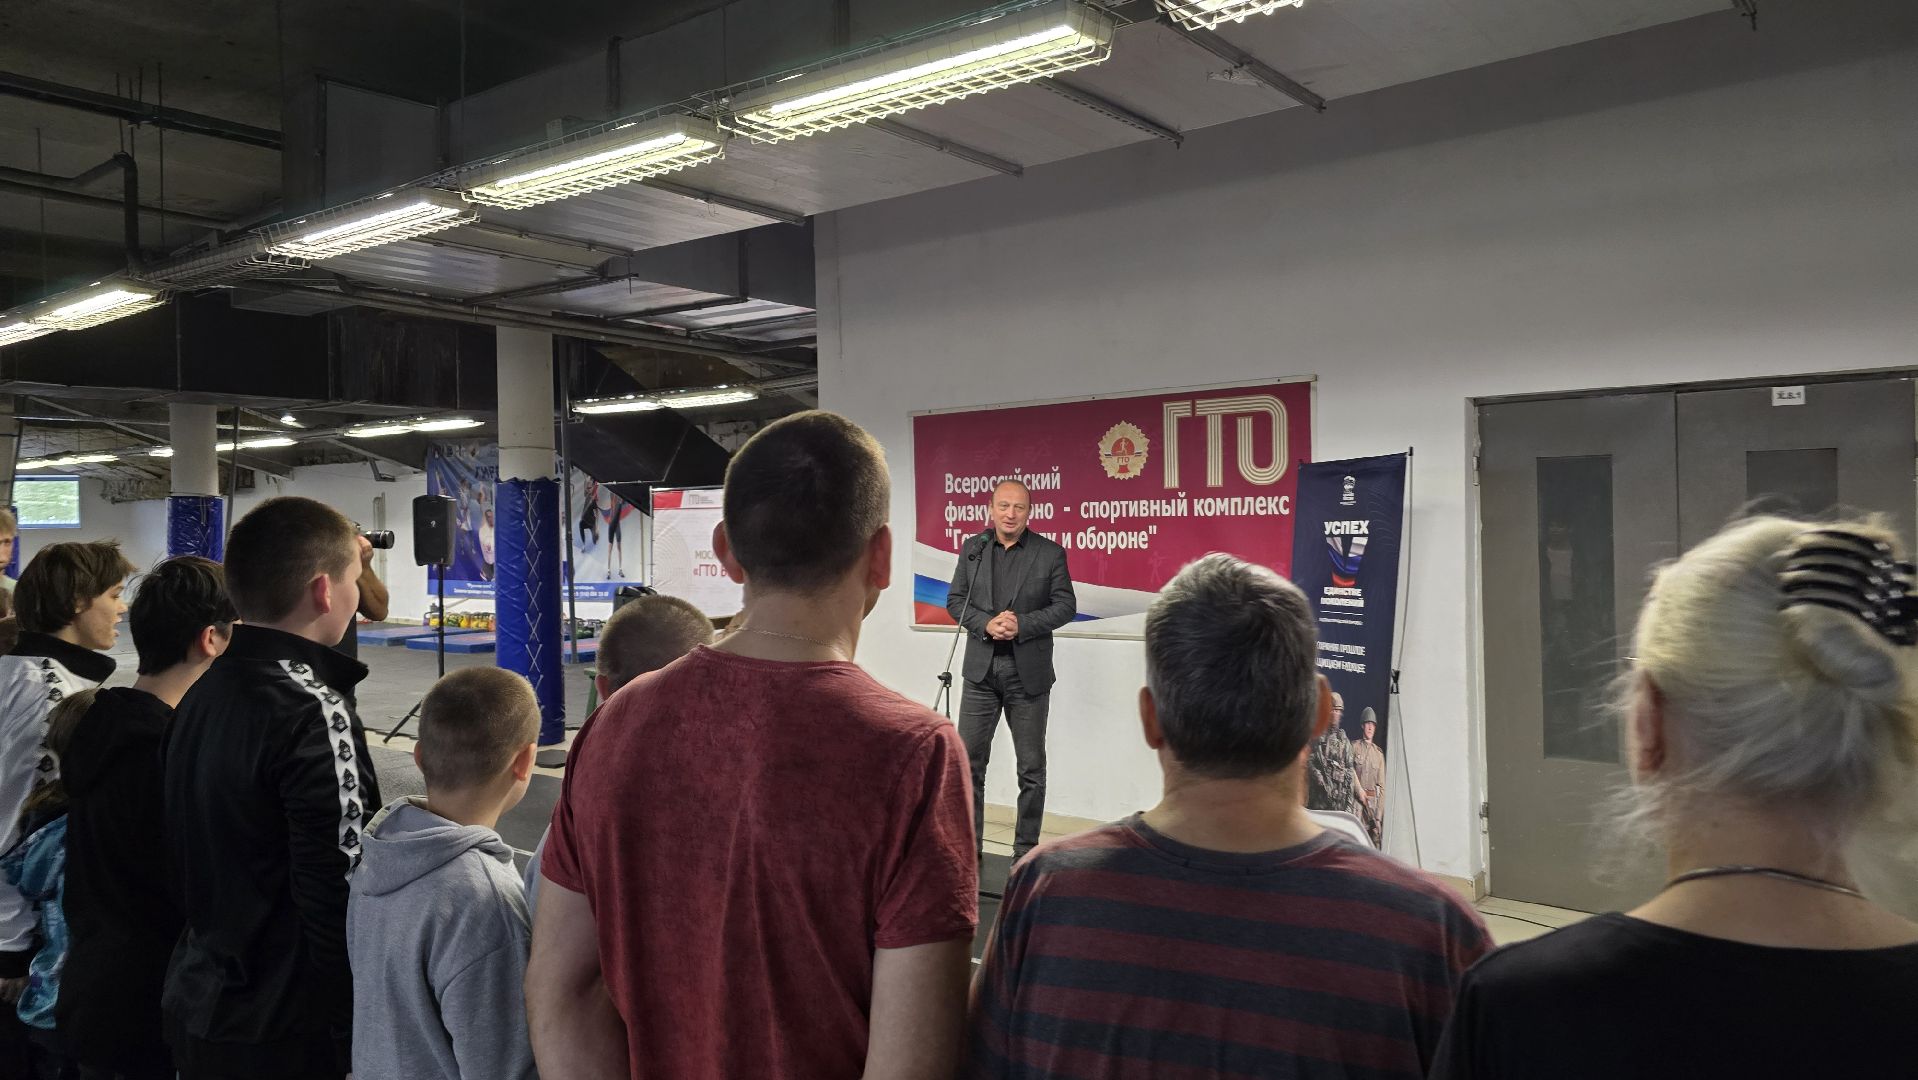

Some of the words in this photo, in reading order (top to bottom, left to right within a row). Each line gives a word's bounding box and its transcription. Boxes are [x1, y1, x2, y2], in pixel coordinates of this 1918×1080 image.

[1163, 394, 1289, 489] ГТО
[945, 466, 1061, 498] Всеросский
[1080, 492, 1188, 524] спортивный
[1193, 495, 1290, 517] комплекс
[1061, 532, 1072, 549] и
[1076, 525, 1157, 555] обороне"
[1323, 520, 1370, 535] УСПЕХ
